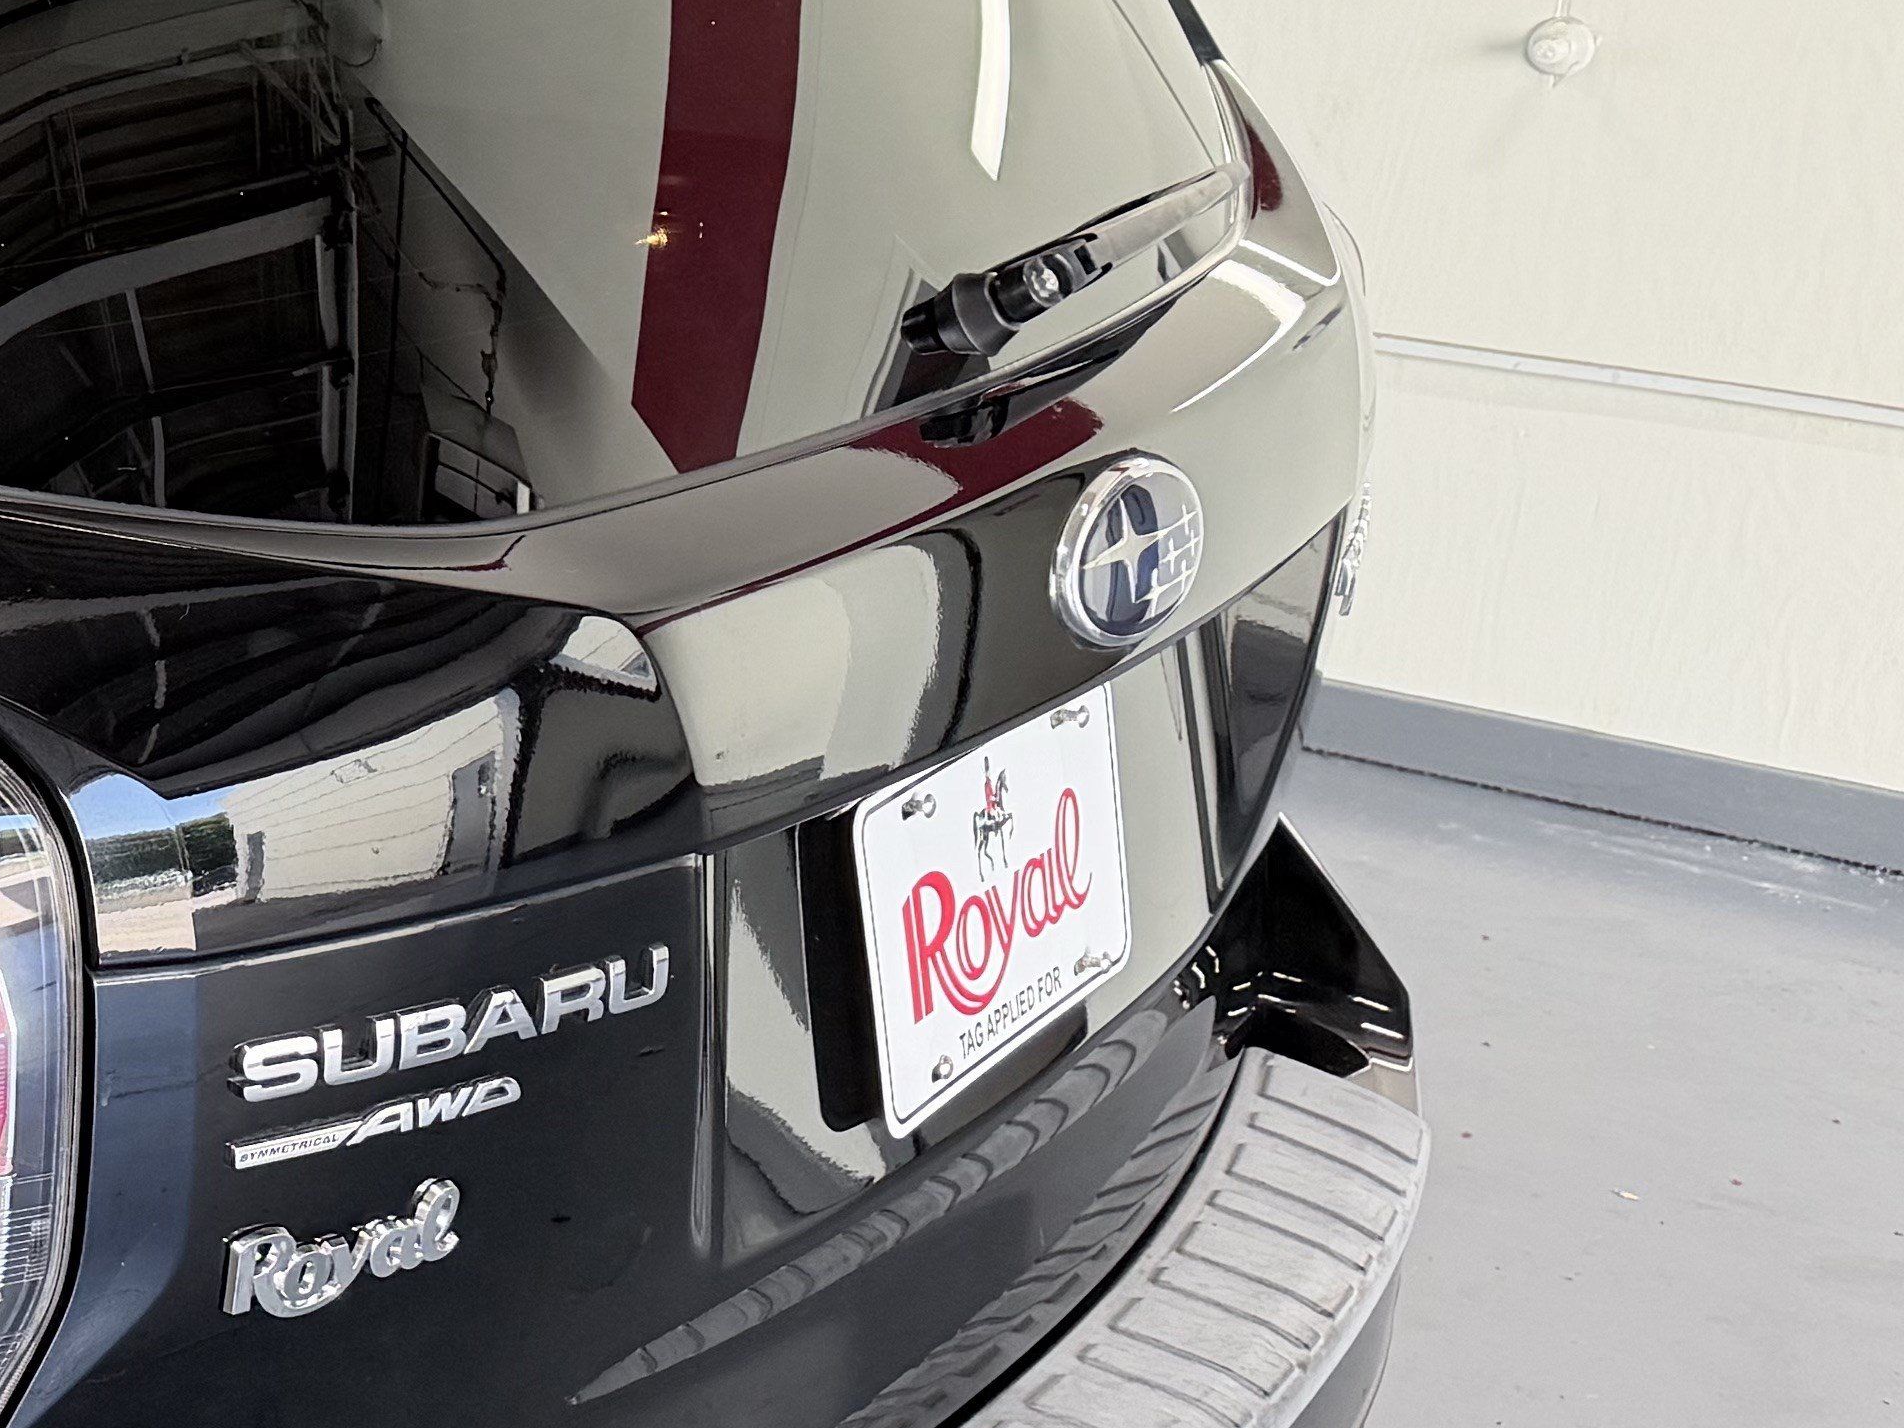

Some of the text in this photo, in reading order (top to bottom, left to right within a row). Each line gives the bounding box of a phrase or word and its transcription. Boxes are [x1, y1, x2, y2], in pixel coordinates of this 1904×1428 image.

[902, 787, 1093, 1024] Royal
[233, 941, 672, 1102] SUBARU
[958, 965, 1063, 1060] TAG APPLIED FOR
[345, 1075, 522, 1148] AWD
[221, 1178, 460, 1318] Royal
